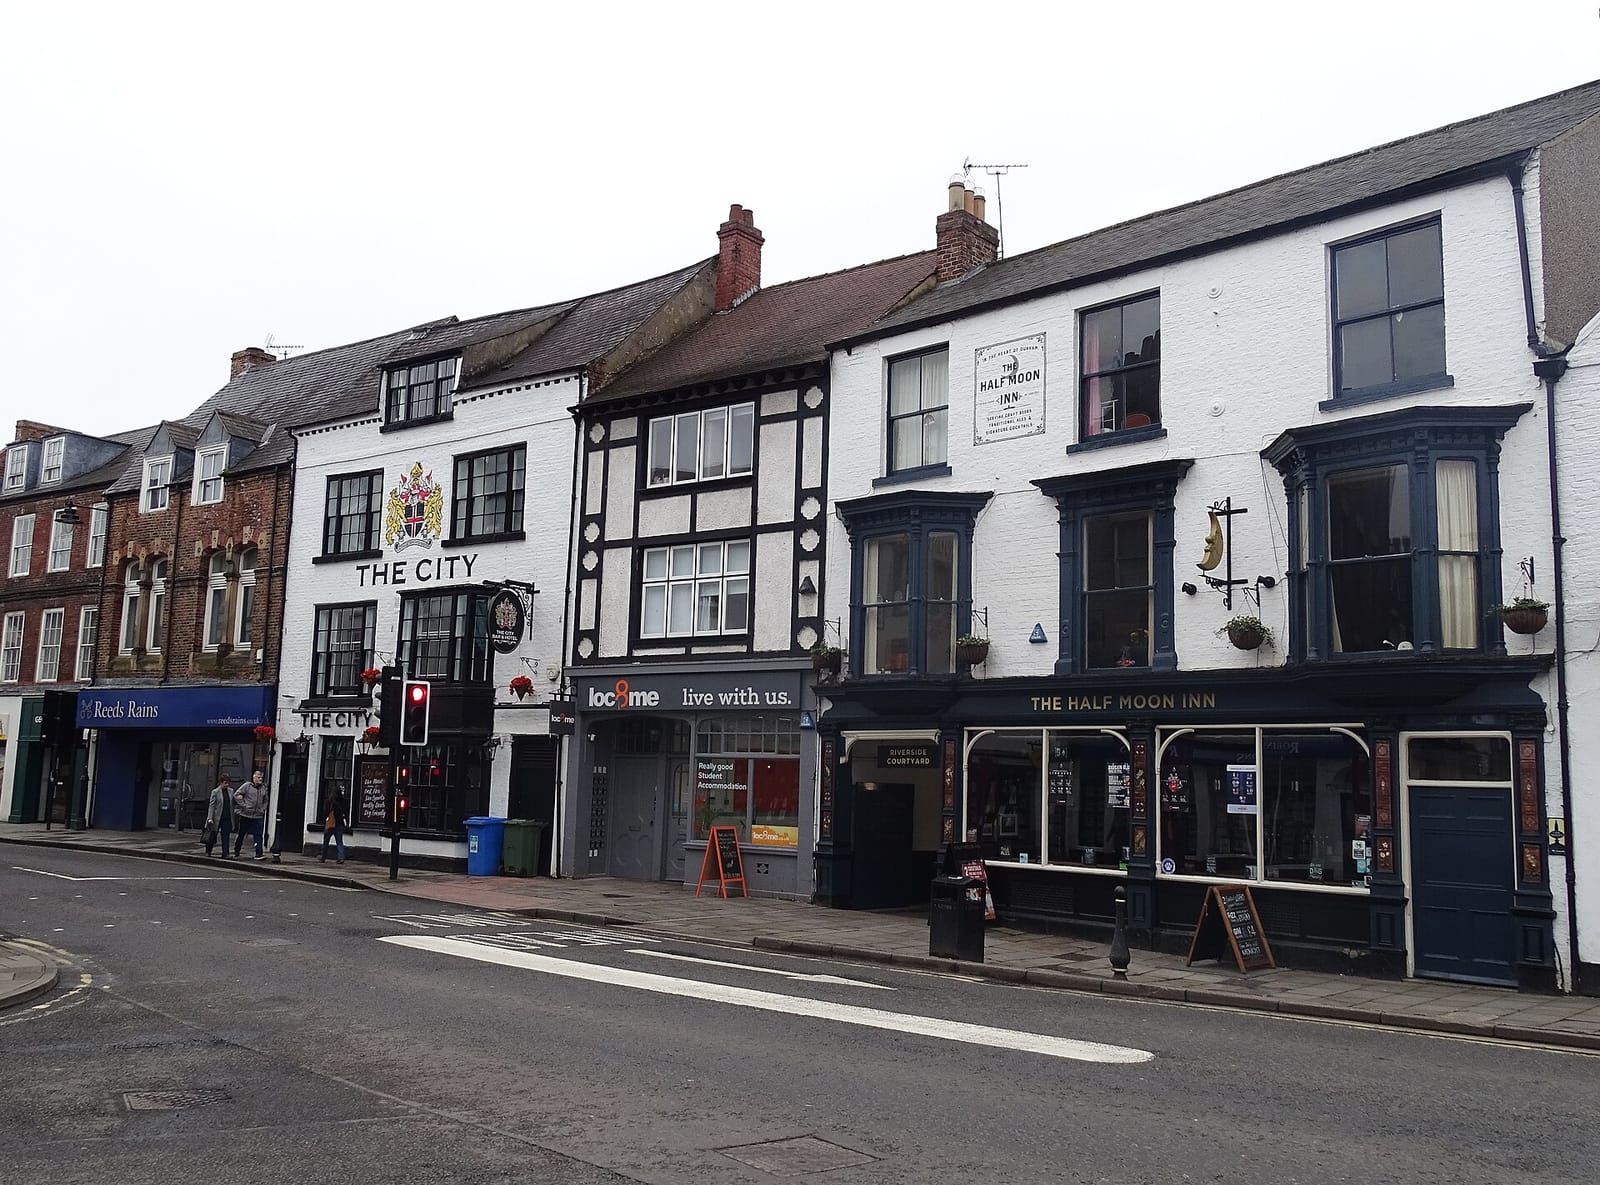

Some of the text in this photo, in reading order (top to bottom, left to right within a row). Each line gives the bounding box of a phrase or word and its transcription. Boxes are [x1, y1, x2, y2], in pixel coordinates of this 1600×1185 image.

[1002, 362, 1018, 372] THE
[980, 369, 1040, 392] HALF MOON
[999, 391, 1019, 405] INN
[356, 554, 478, 587] THE CITY
[589, 679, 660, 709] loc8me
[682, 687, 792, 706] live with us.
[94, 699, 159, 719] Reeds Rains
[1031, 693, 1216, 711] THE HALF MOON INN
[207, 716, 260, 725] www.reedsrains.co.uk
[301, 712, 373, 728] THE CITY
[551, 712, 575, 724] loc8me
[698, 762, 734, 771] Really good
[886, 757, 930, 765] COURTYARD
[698, 772, 722, 780] Student
[697, 781, 747, 790] Accommodation
